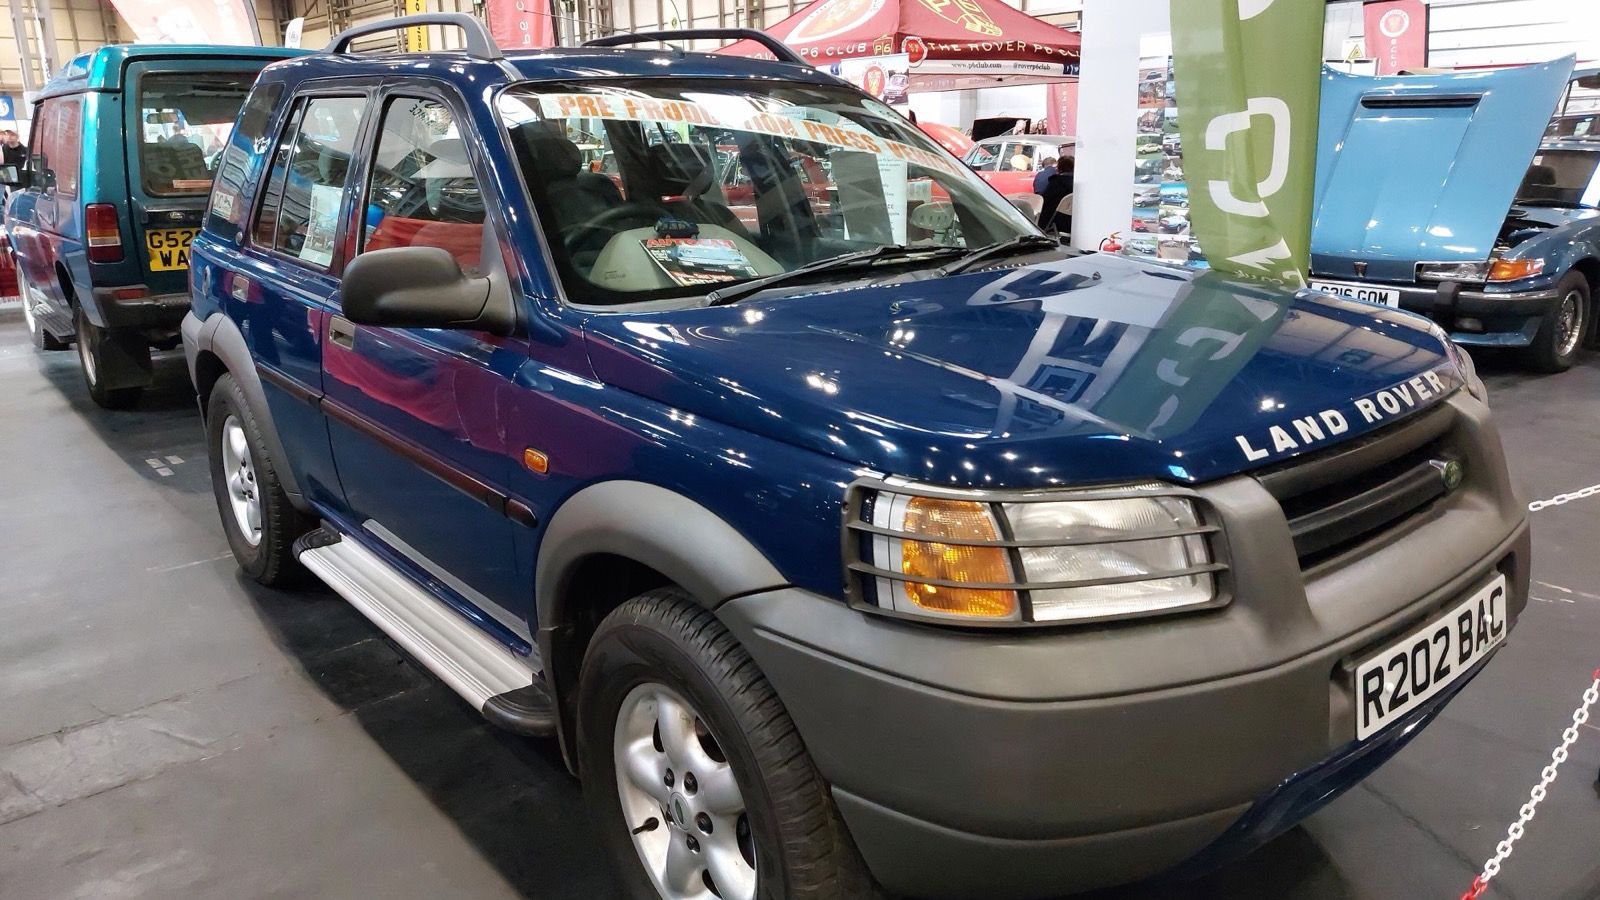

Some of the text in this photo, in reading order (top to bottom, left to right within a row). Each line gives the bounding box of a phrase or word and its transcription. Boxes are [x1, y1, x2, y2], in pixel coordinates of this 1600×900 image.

[800, 42, 867, 57] P6 CLUB
[874, 43, 890, 55] P6
[927, 42, 961, 51] THE
[967, 40, 1026, 52] ROVER
[951, 62, 1051, 72] www.p6club.com @roverp6club
[558, 95, 616, 117] PRE
[623, 98, 799, 137] PRODUION
[803, 120, 881, 153] PRESS
[160, 250, 190, 267] WA
[1235, 370, 1446, 462] LAND ROVER
[1362, 585, 1504, 729] R202 BAC
